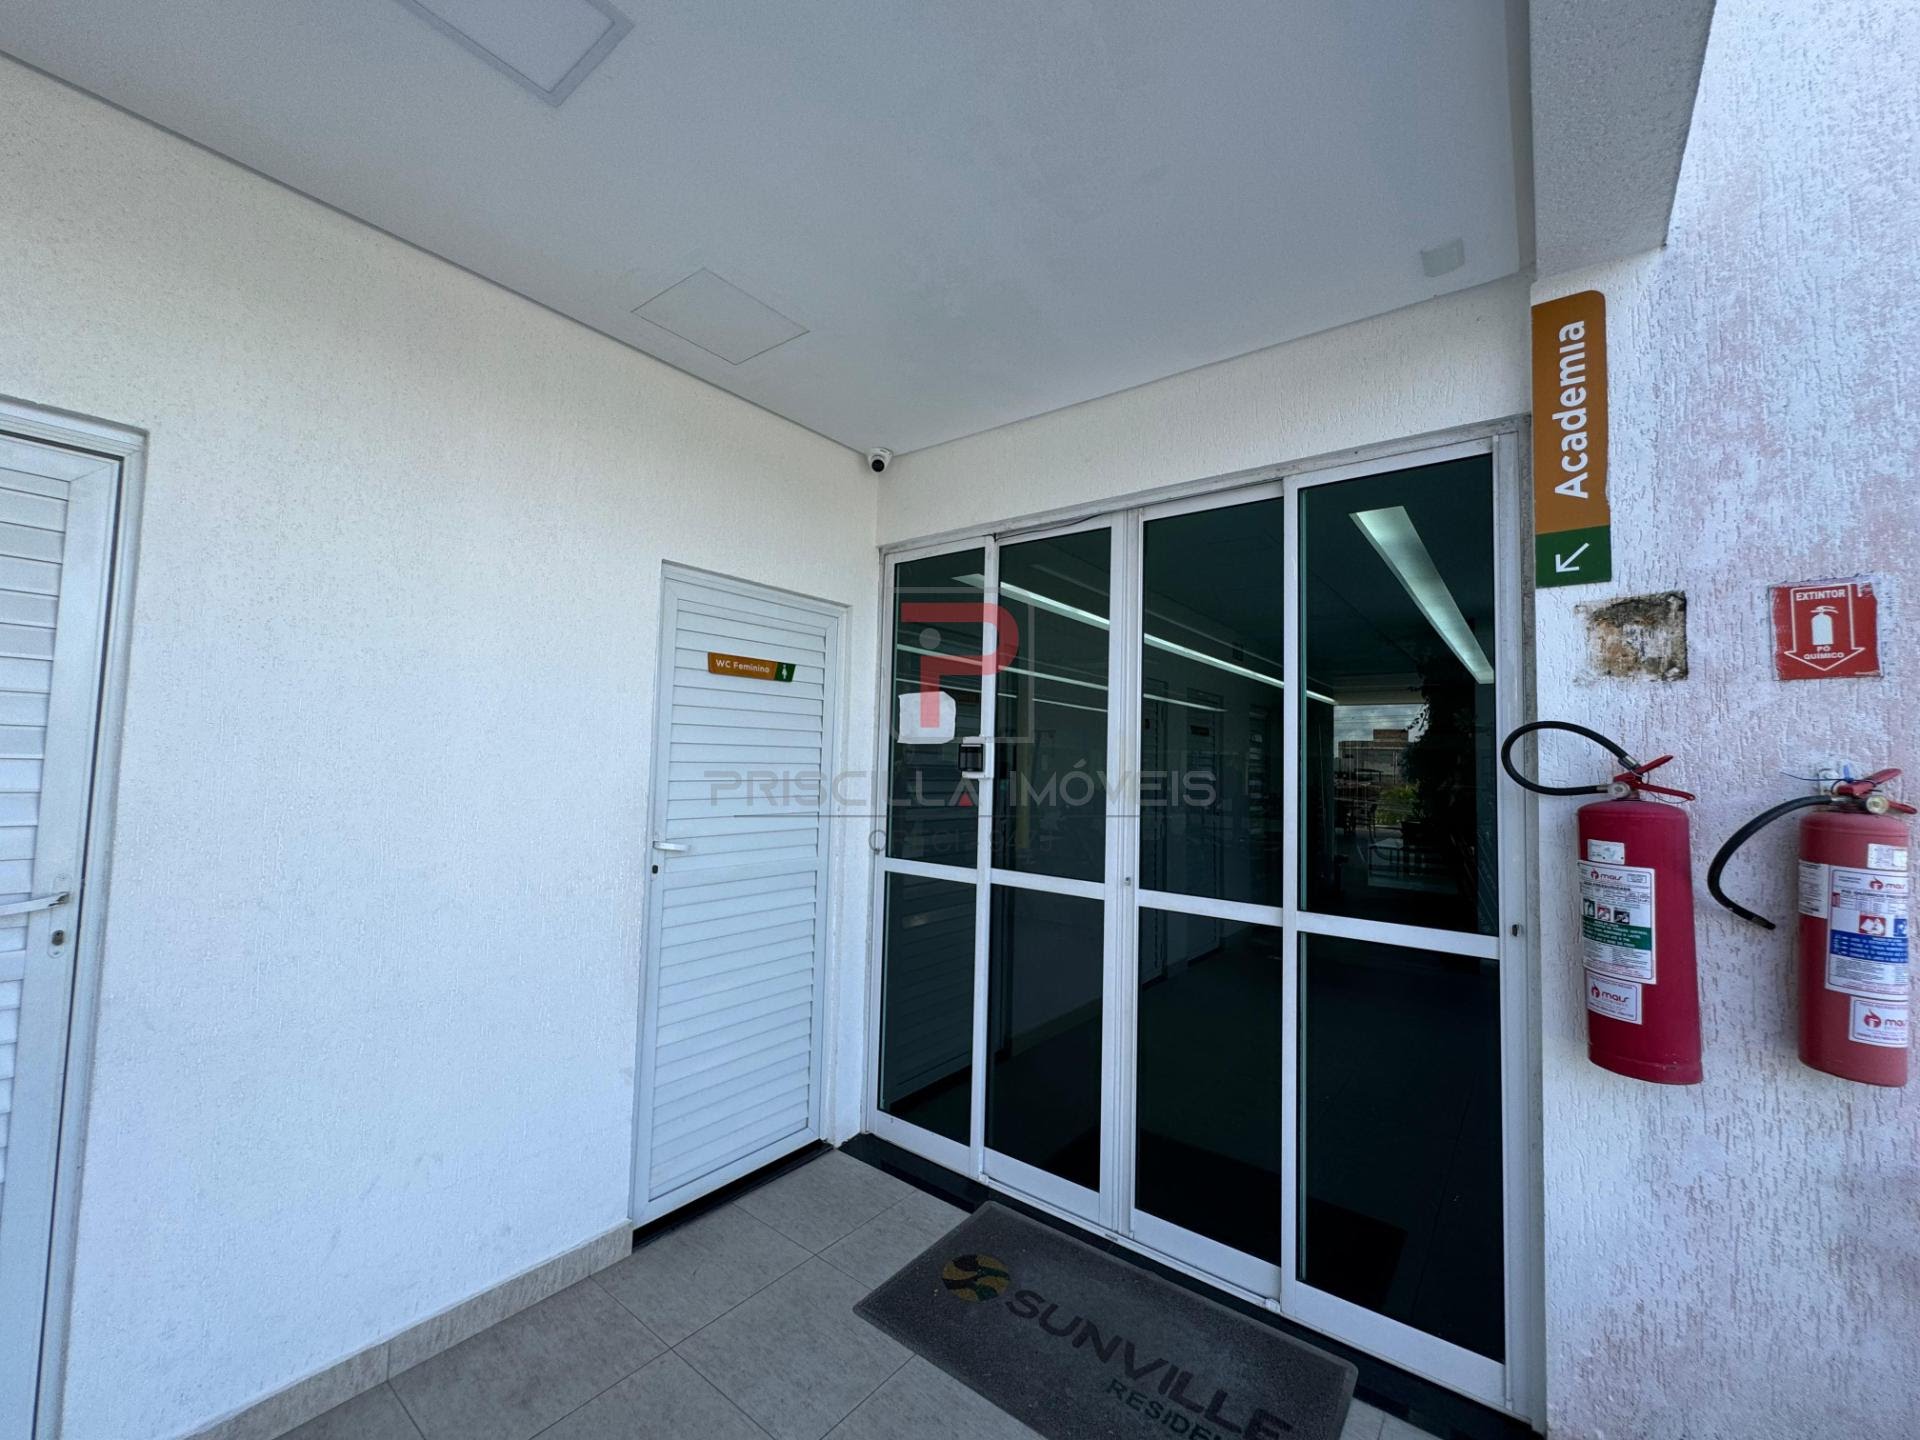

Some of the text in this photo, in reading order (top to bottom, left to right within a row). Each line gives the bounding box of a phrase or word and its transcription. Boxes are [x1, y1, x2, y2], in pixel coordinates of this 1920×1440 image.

[1552, 320, 1589, 499] Academia
[1796, 589, 1845, 601] EXTINTOR
[715, 659, 770, 673] WC Feminino
[1005, 1289, 1294, 1440] SUNVILLE
[1105, 1378, 1223, 1440] RESIDE
